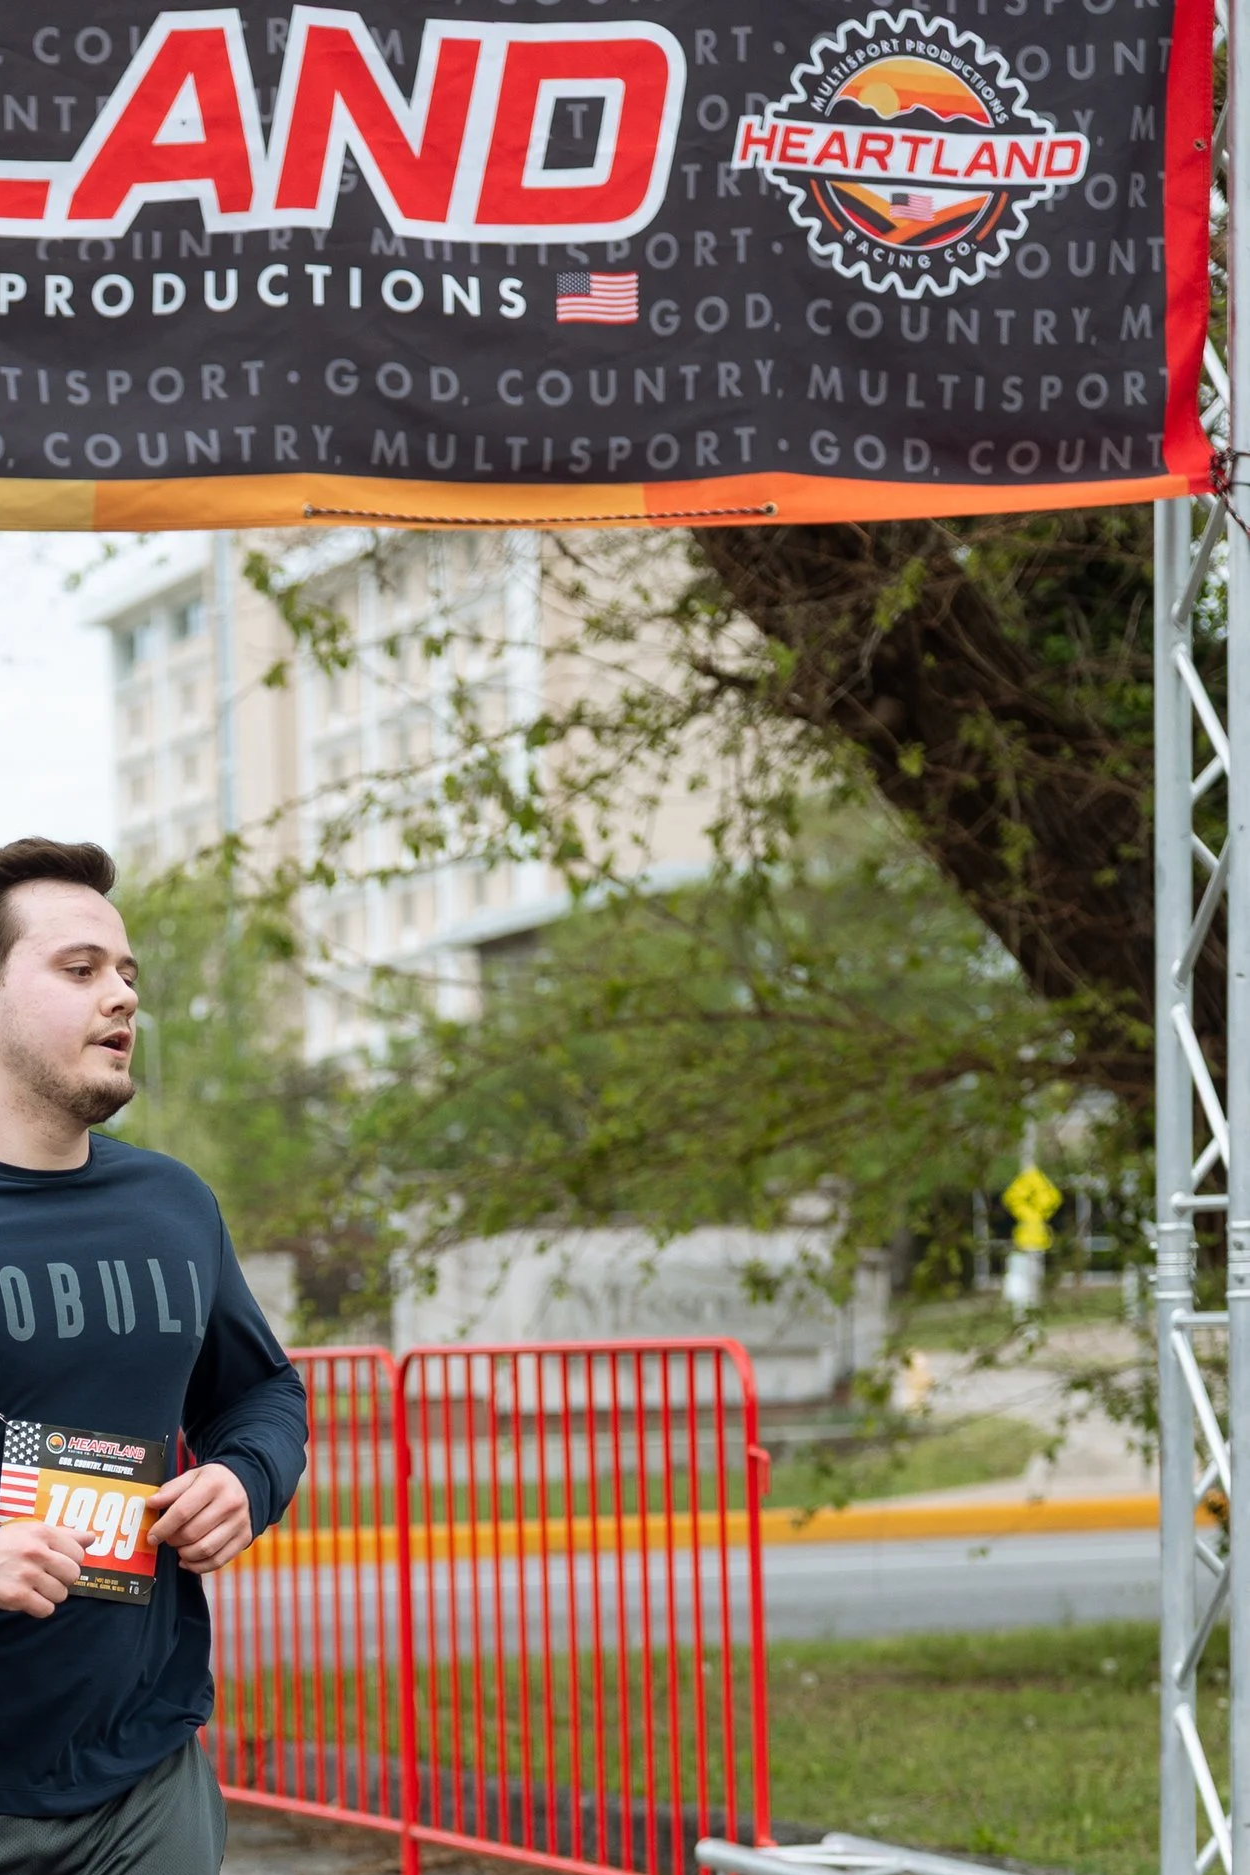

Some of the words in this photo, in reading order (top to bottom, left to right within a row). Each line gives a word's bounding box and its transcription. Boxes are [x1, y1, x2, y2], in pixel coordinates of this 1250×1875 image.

[810, 37, 900, 114] MULTISPORT
[904, 38, 1010, 125] PRODUCTIONS
[735, 118, 1087, 183] HEARTLAND
[842, 229, 932, 269] RACING
[943, 241, 977, 265] CO.
[650, 293, 782, 337] GOD,
[806, 299, 1098, 346] COUNTRY,
[324, 358, 470, 407] GOD,
[497, 359, 785, 407] COUNTRY,
[43, 424, 343, 468] COUNTRY,
[370, 426, 757, 474] MULTISPORT
[809, 428, 941, 477] GOD,
[68, 1436, 146, 1460] HEARTLAND
[44, 1484, 147, 1561] 1999
